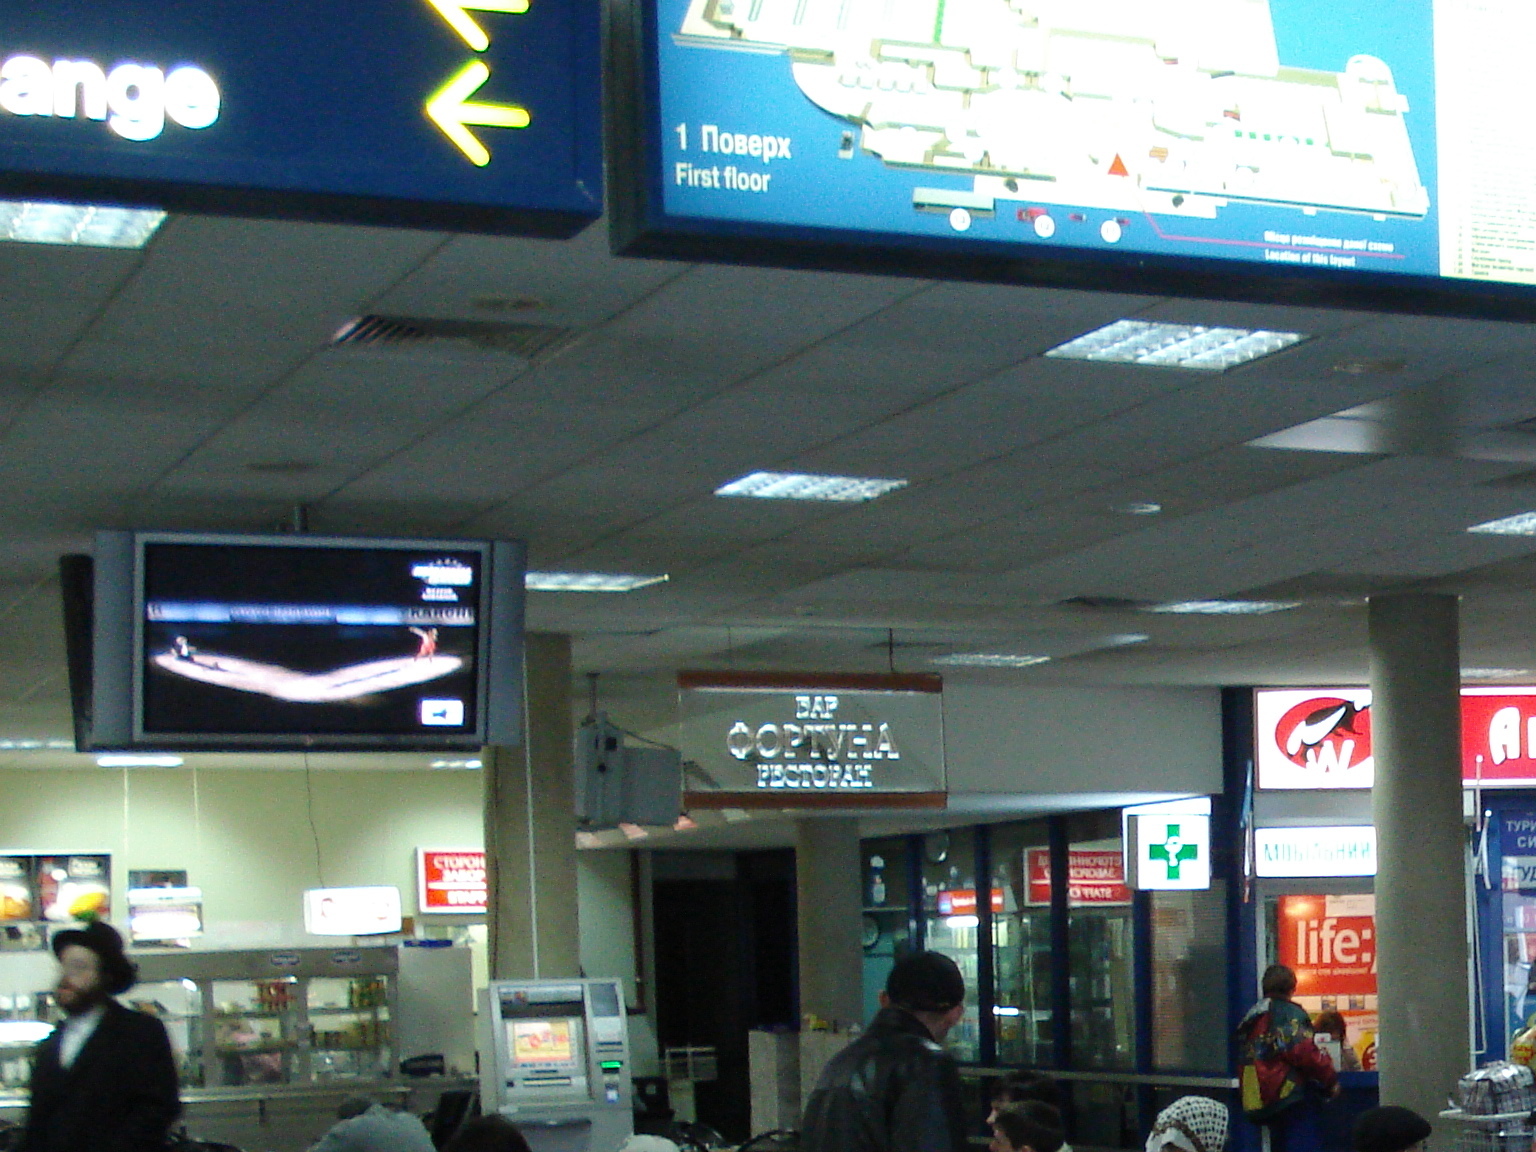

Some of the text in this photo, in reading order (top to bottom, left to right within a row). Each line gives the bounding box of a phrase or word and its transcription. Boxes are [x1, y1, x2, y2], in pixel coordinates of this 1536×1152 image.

[675, 122, 792, 164] 1 Поверх
[675, 162, 771, 193] First floor
[795, 695, 839, 720] БАР
[727, 720, 900, 760] ФОРТУНА
[757, 763, 873, 788] РЕСТОРАН
